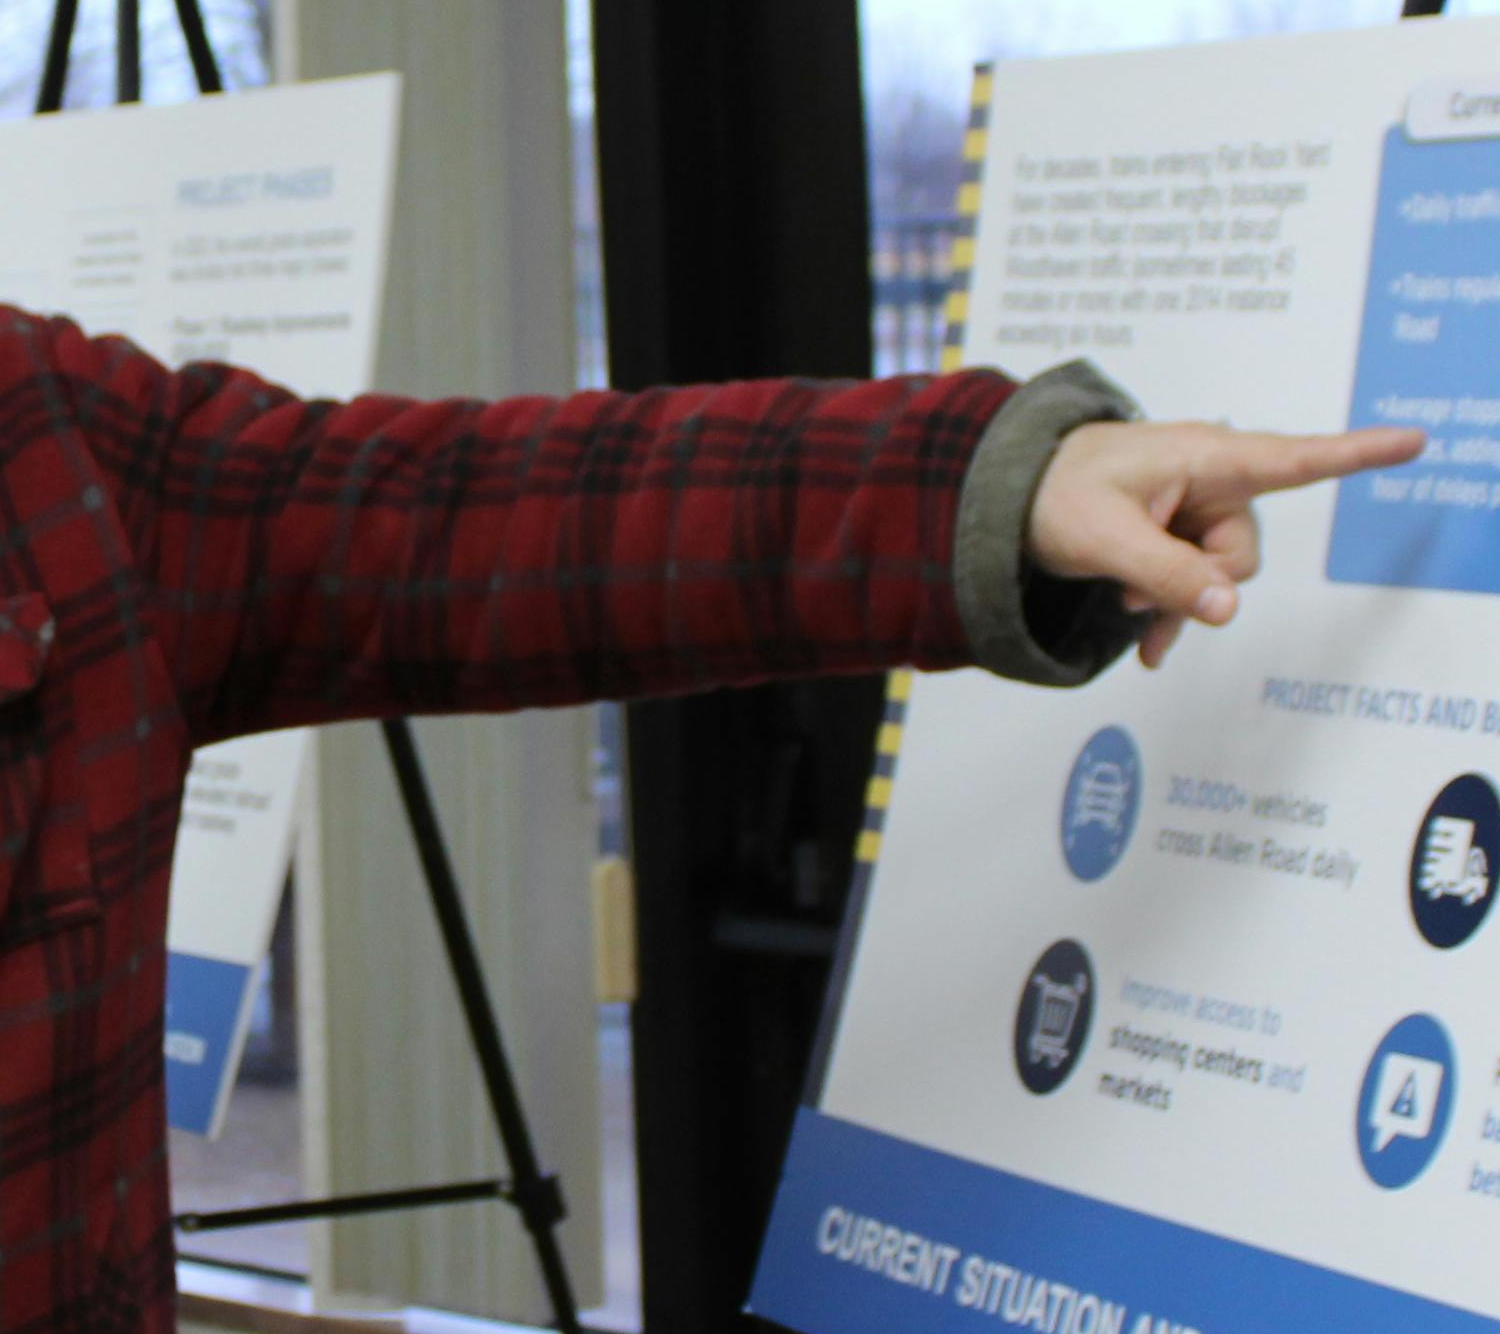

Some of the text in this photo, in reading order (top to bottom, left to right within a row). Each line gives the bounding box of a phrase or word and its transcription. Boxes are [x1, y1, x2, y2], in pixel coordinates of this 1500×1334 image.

[1263, 678, 1350, 715] PROJECT
[1356, 687, 1422, 725] FACTS
[1427, 696, 1476, 731] AND
[1109, 1024, 1306, 1095] shopping centers and
[1098, 1072, 1173, 1111] markets
[817, 1205, 961, 1296] CURRENT
